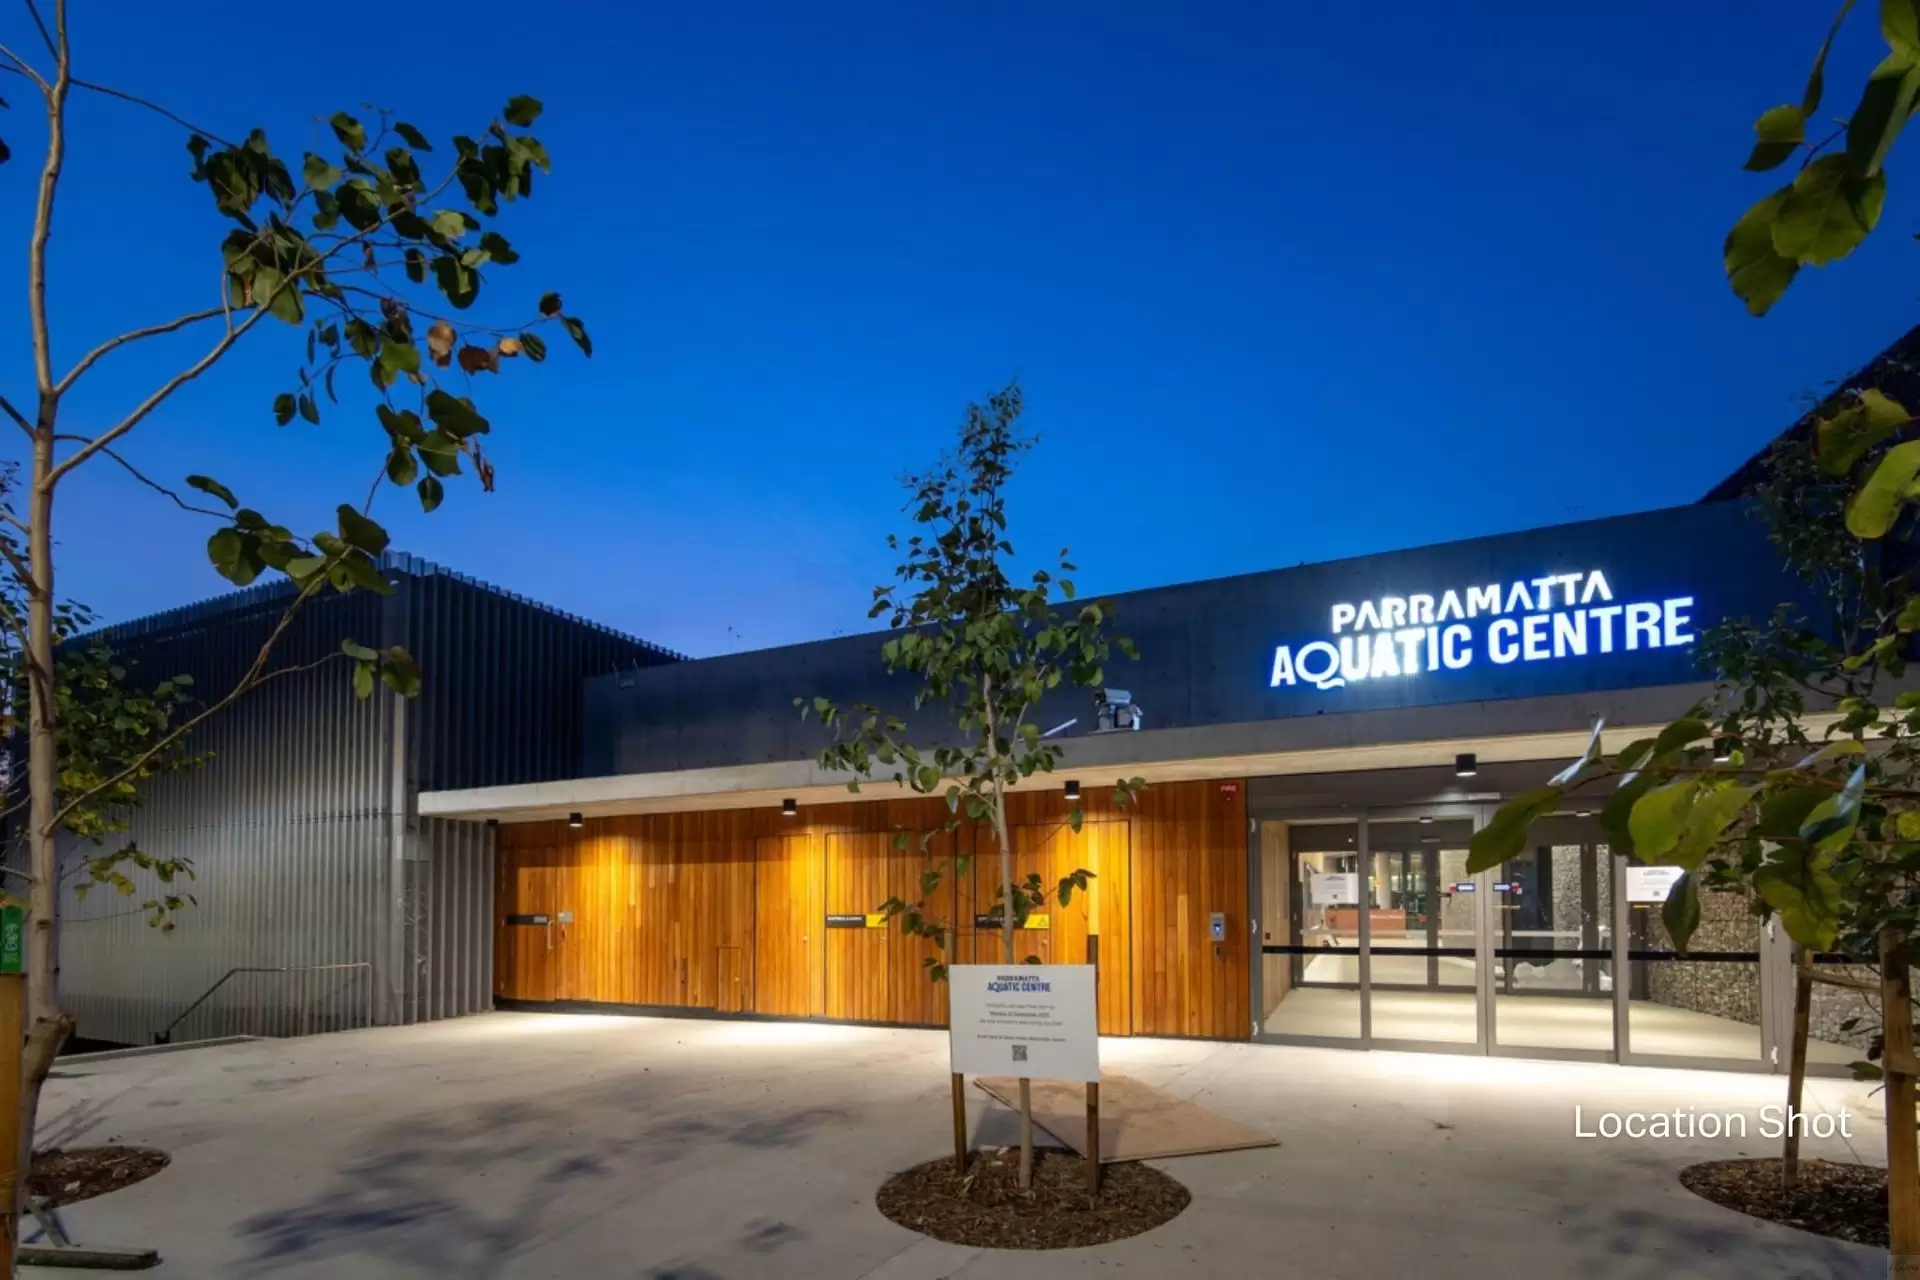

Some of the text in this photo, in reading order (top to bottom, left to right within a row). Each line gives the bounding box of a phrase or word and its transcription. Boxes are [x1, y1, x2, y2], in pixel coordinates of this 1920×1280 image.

[1331, 570, 1613, 633] PARRAMATTA
[1270, 596, 1694, 690] AQUATIC CENTRE
[987, 982, 1051, 992] AQUATIC CENTRE
